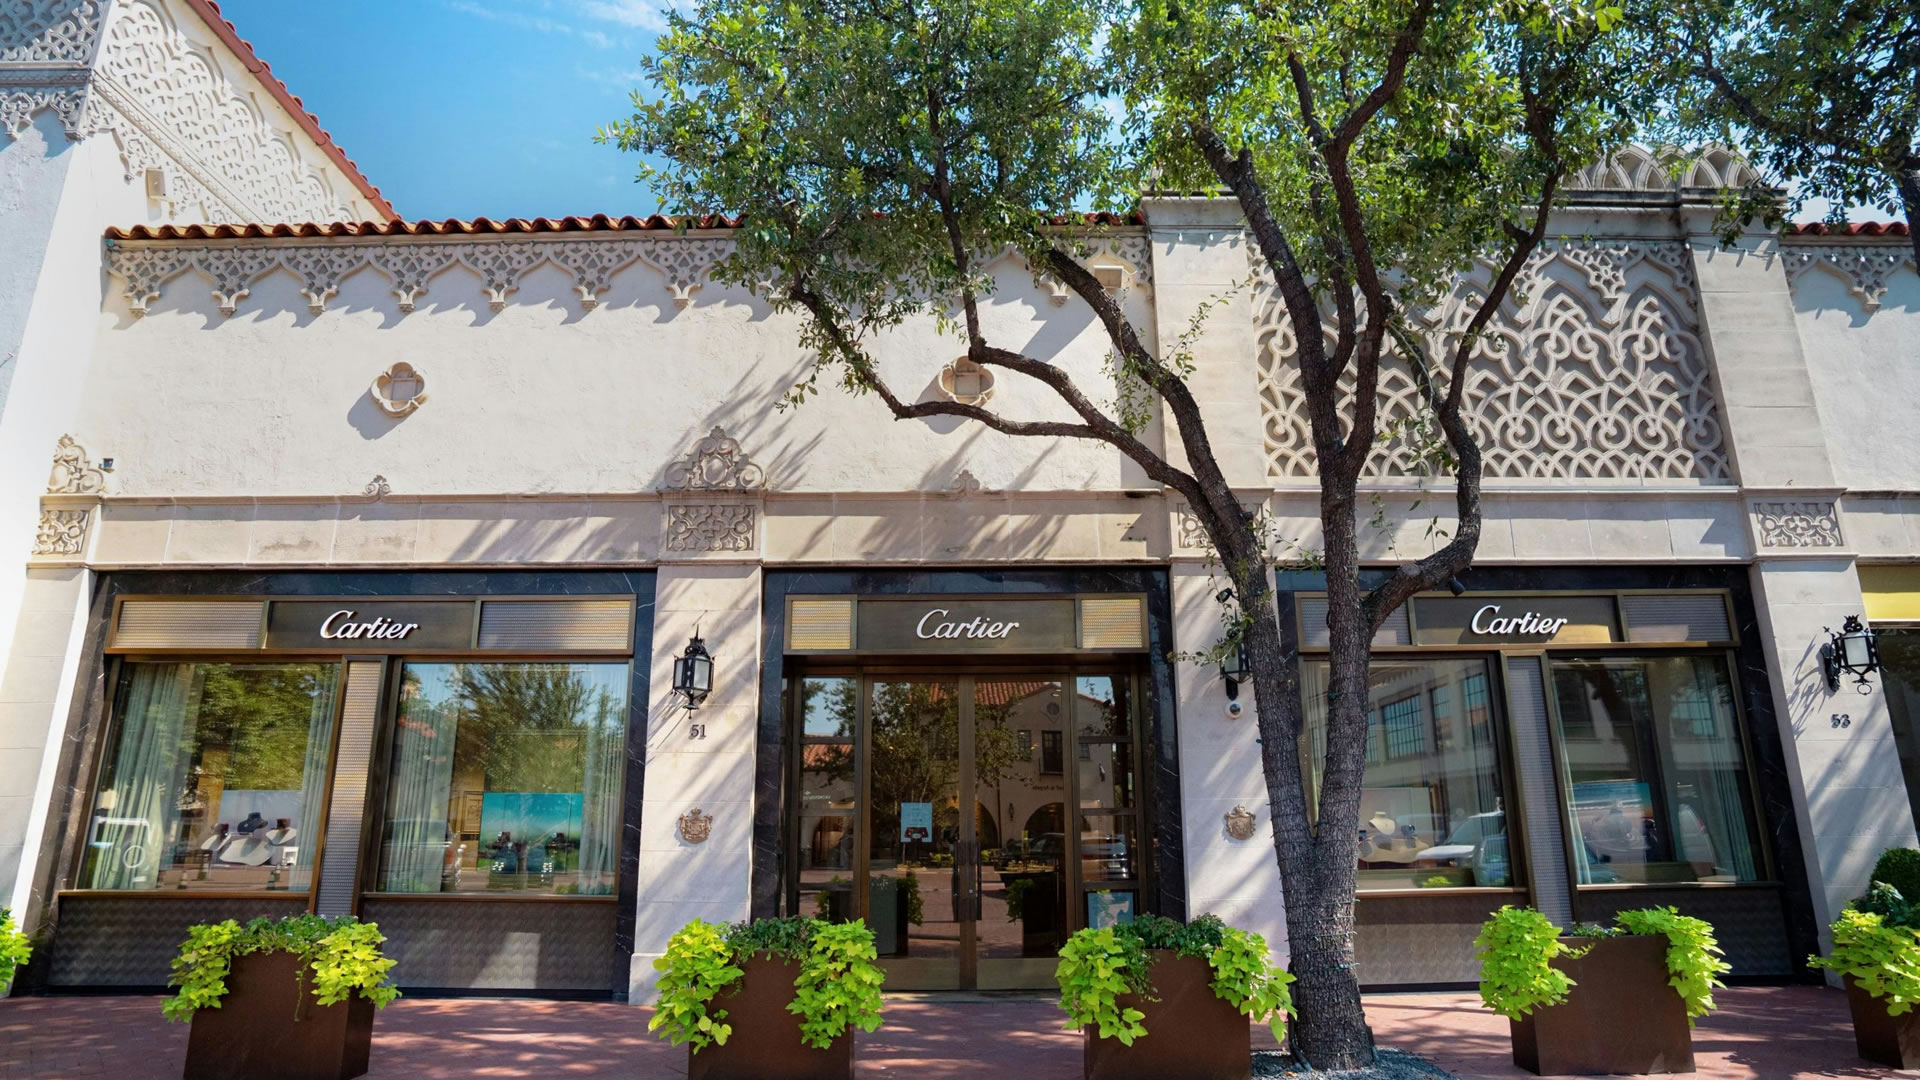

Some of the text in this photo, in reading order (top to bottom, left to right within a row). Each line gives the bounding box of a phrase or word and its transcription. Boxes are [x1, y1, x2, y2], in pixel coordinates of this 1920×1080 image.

[320, 610, 418, 638] Cartier
[916, 609, 1019, 638] Cartier
[1471, 605, 1567, 634] Cartier
[690, 724, 706, 738] 51
[1831, 713, 1850, 728] 53
